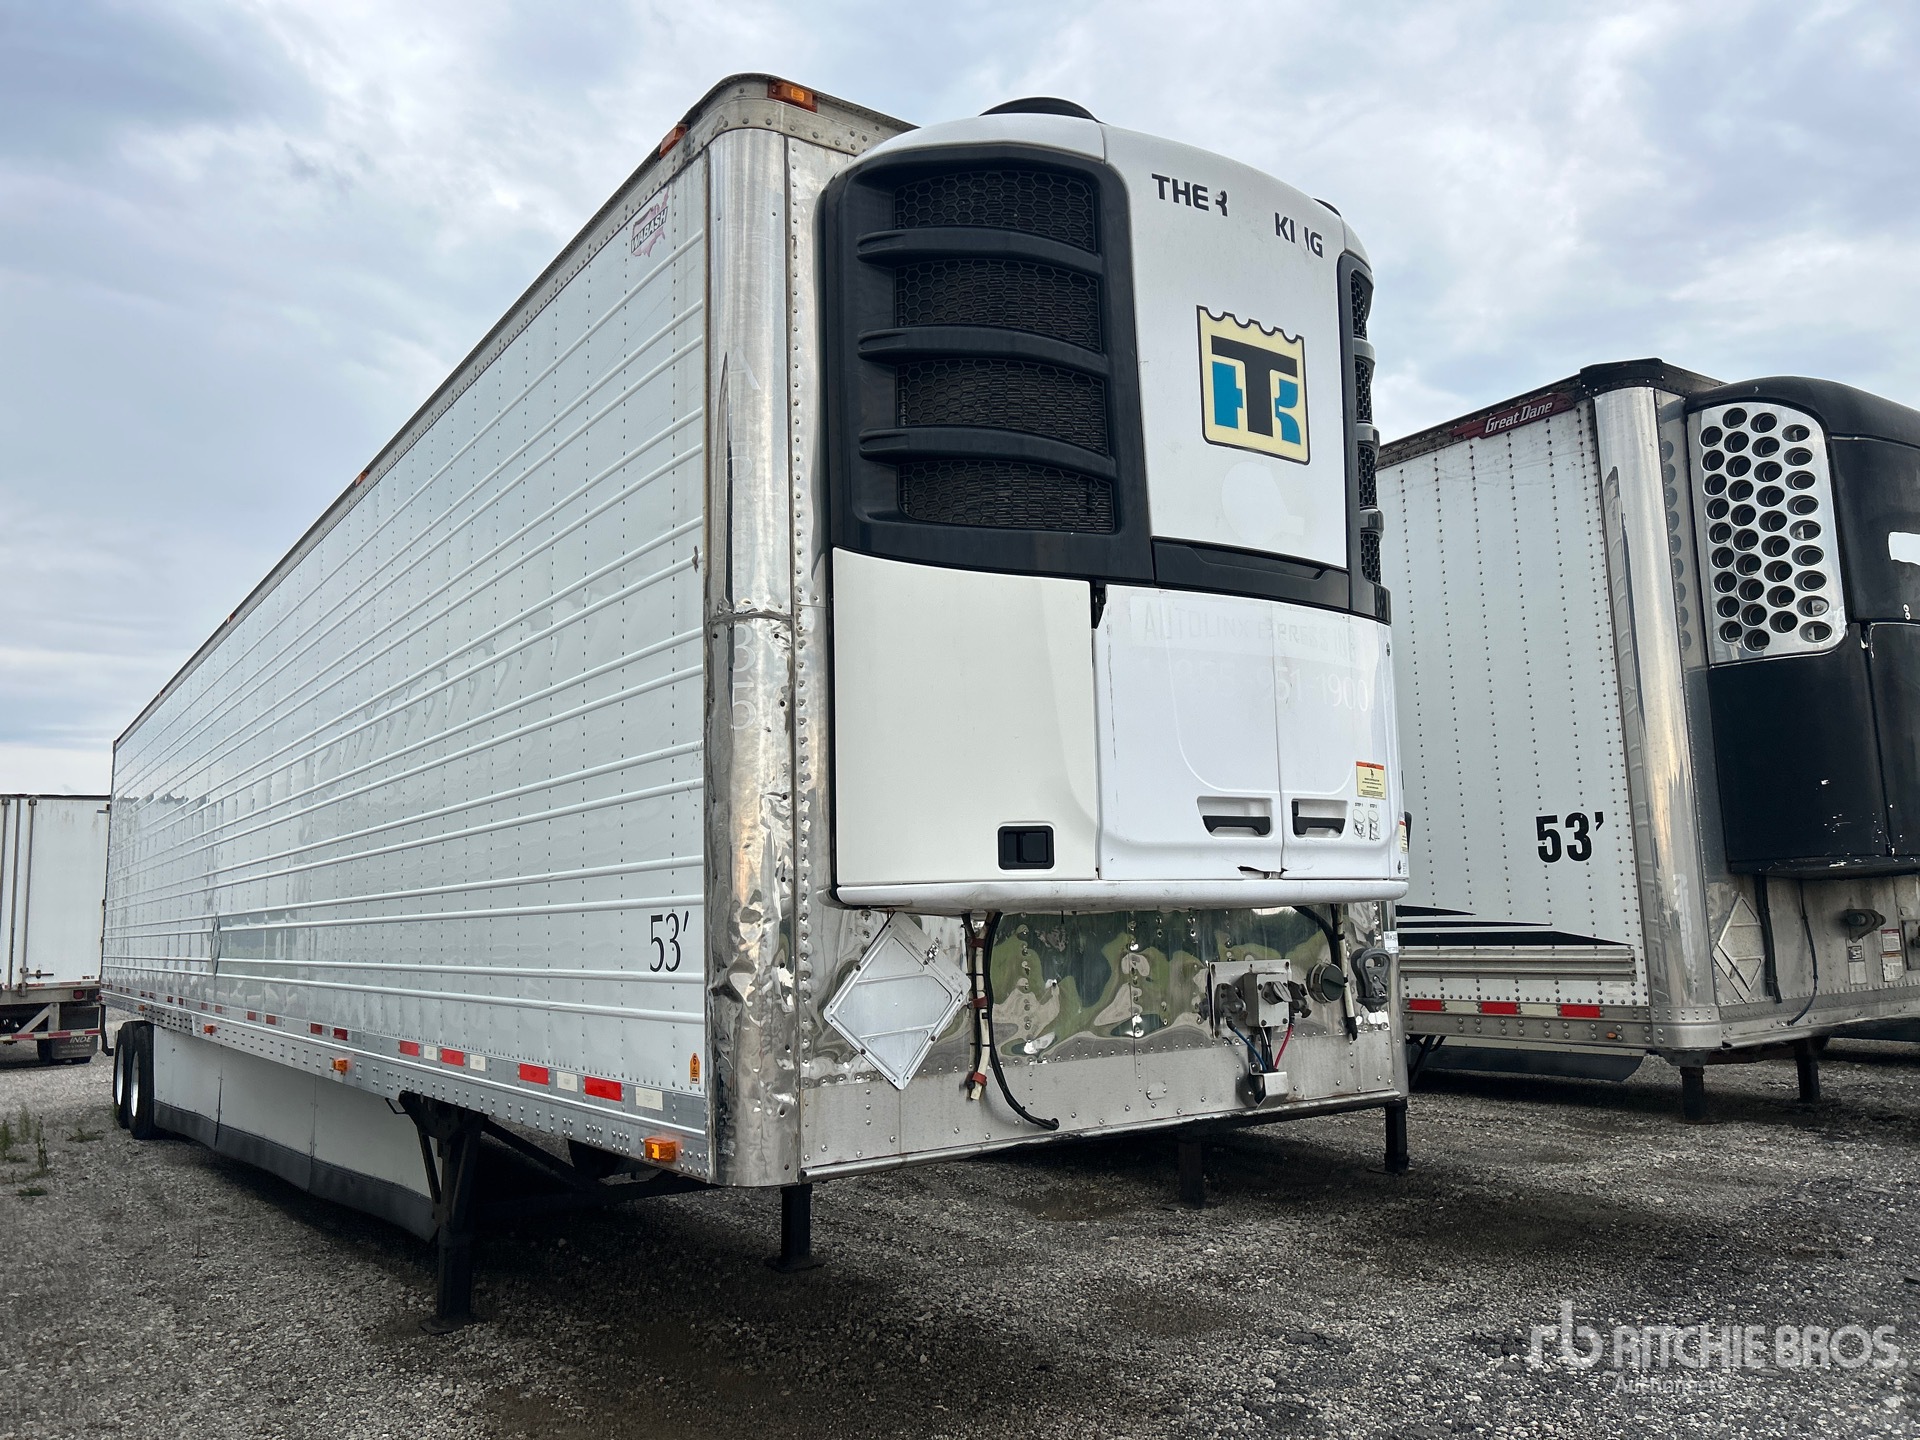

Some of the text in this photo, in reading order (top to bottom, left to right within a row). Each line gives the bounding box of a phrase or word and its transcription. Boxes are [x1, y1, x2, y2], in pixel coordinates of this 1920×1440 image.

[631, 207, 668, 252] WABASH
[1485, 402, 1553, 433] Great Dane
[1535, 811, 1605, 863] 53'
[649, 910, 690, 973] 53'
